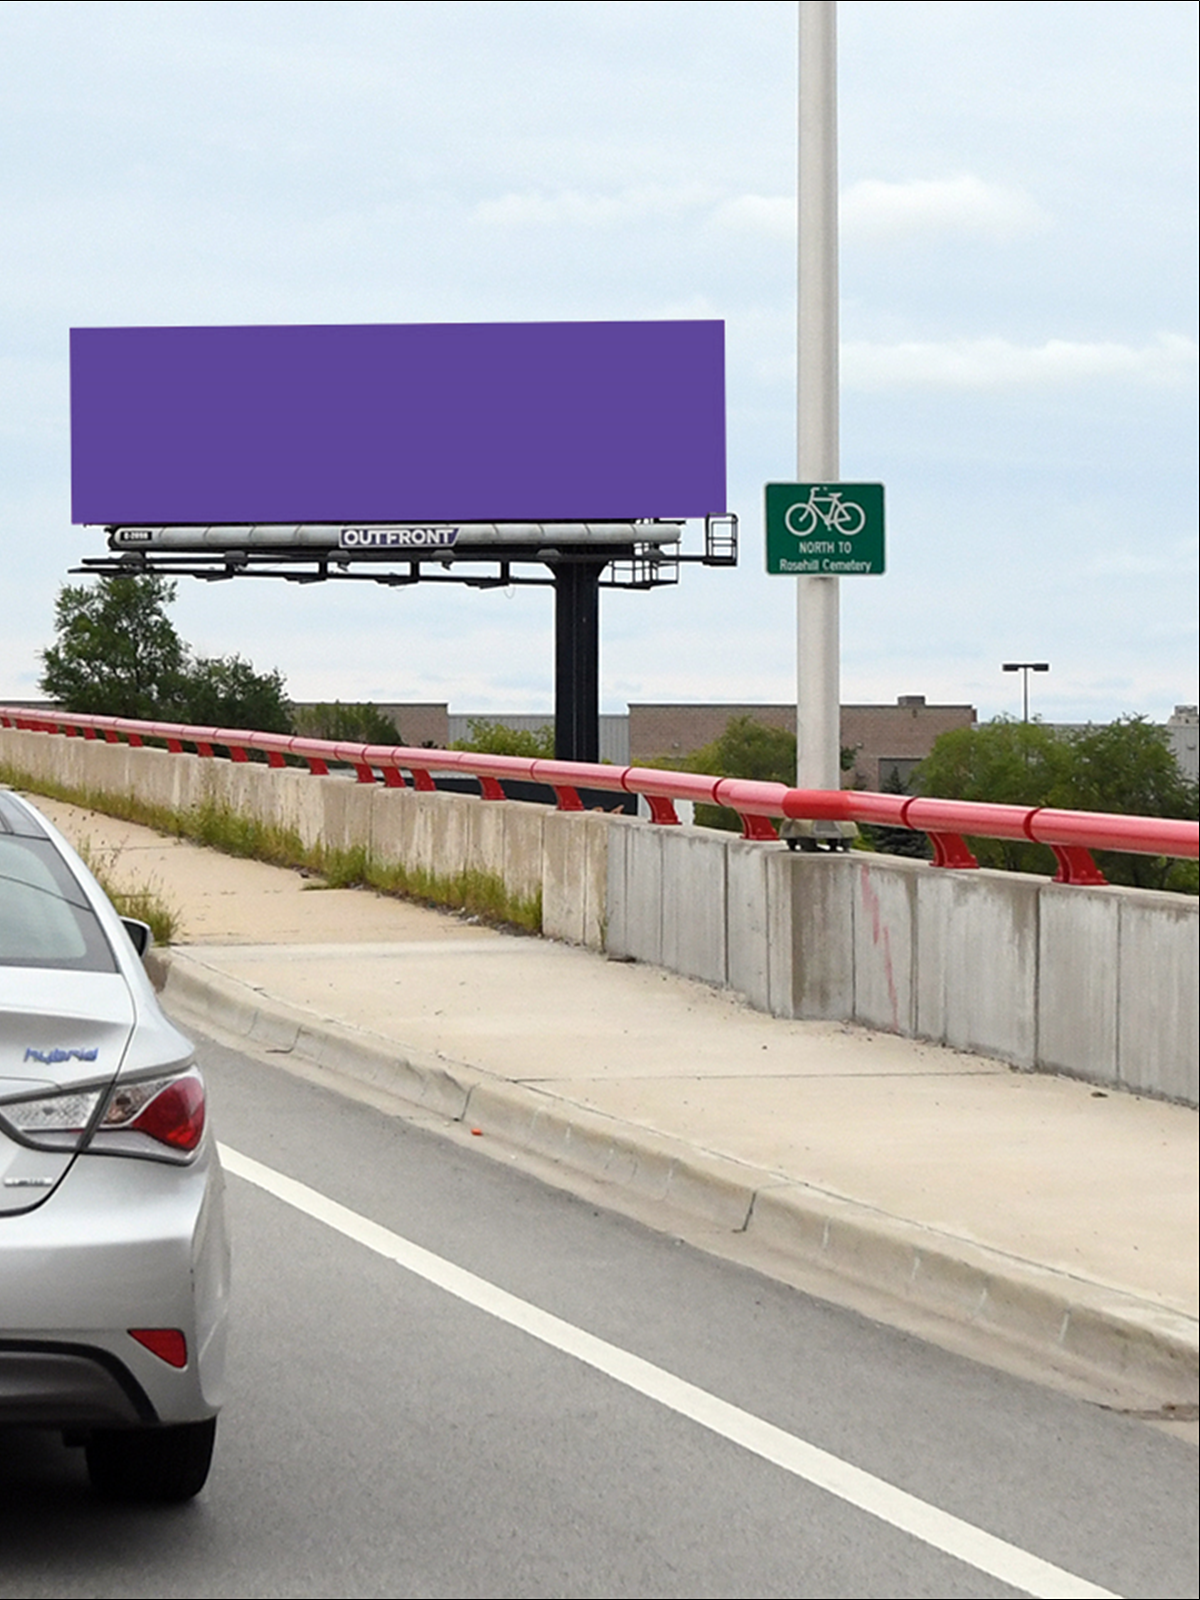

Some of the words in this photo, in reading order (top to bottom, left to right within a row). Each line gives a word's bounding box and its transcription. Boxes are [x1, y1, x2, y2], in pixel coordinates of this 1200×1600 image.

[344, 530, 453, 545] OUTFRONT
[799, 541, 835, 554] NORTH
[838, 541, 852, 554] TO
[780, 559, 820, 571] Rosehill
[822, 559, 872, 573] Cemetery
[23, 1047, 99, 1065] hybrid
